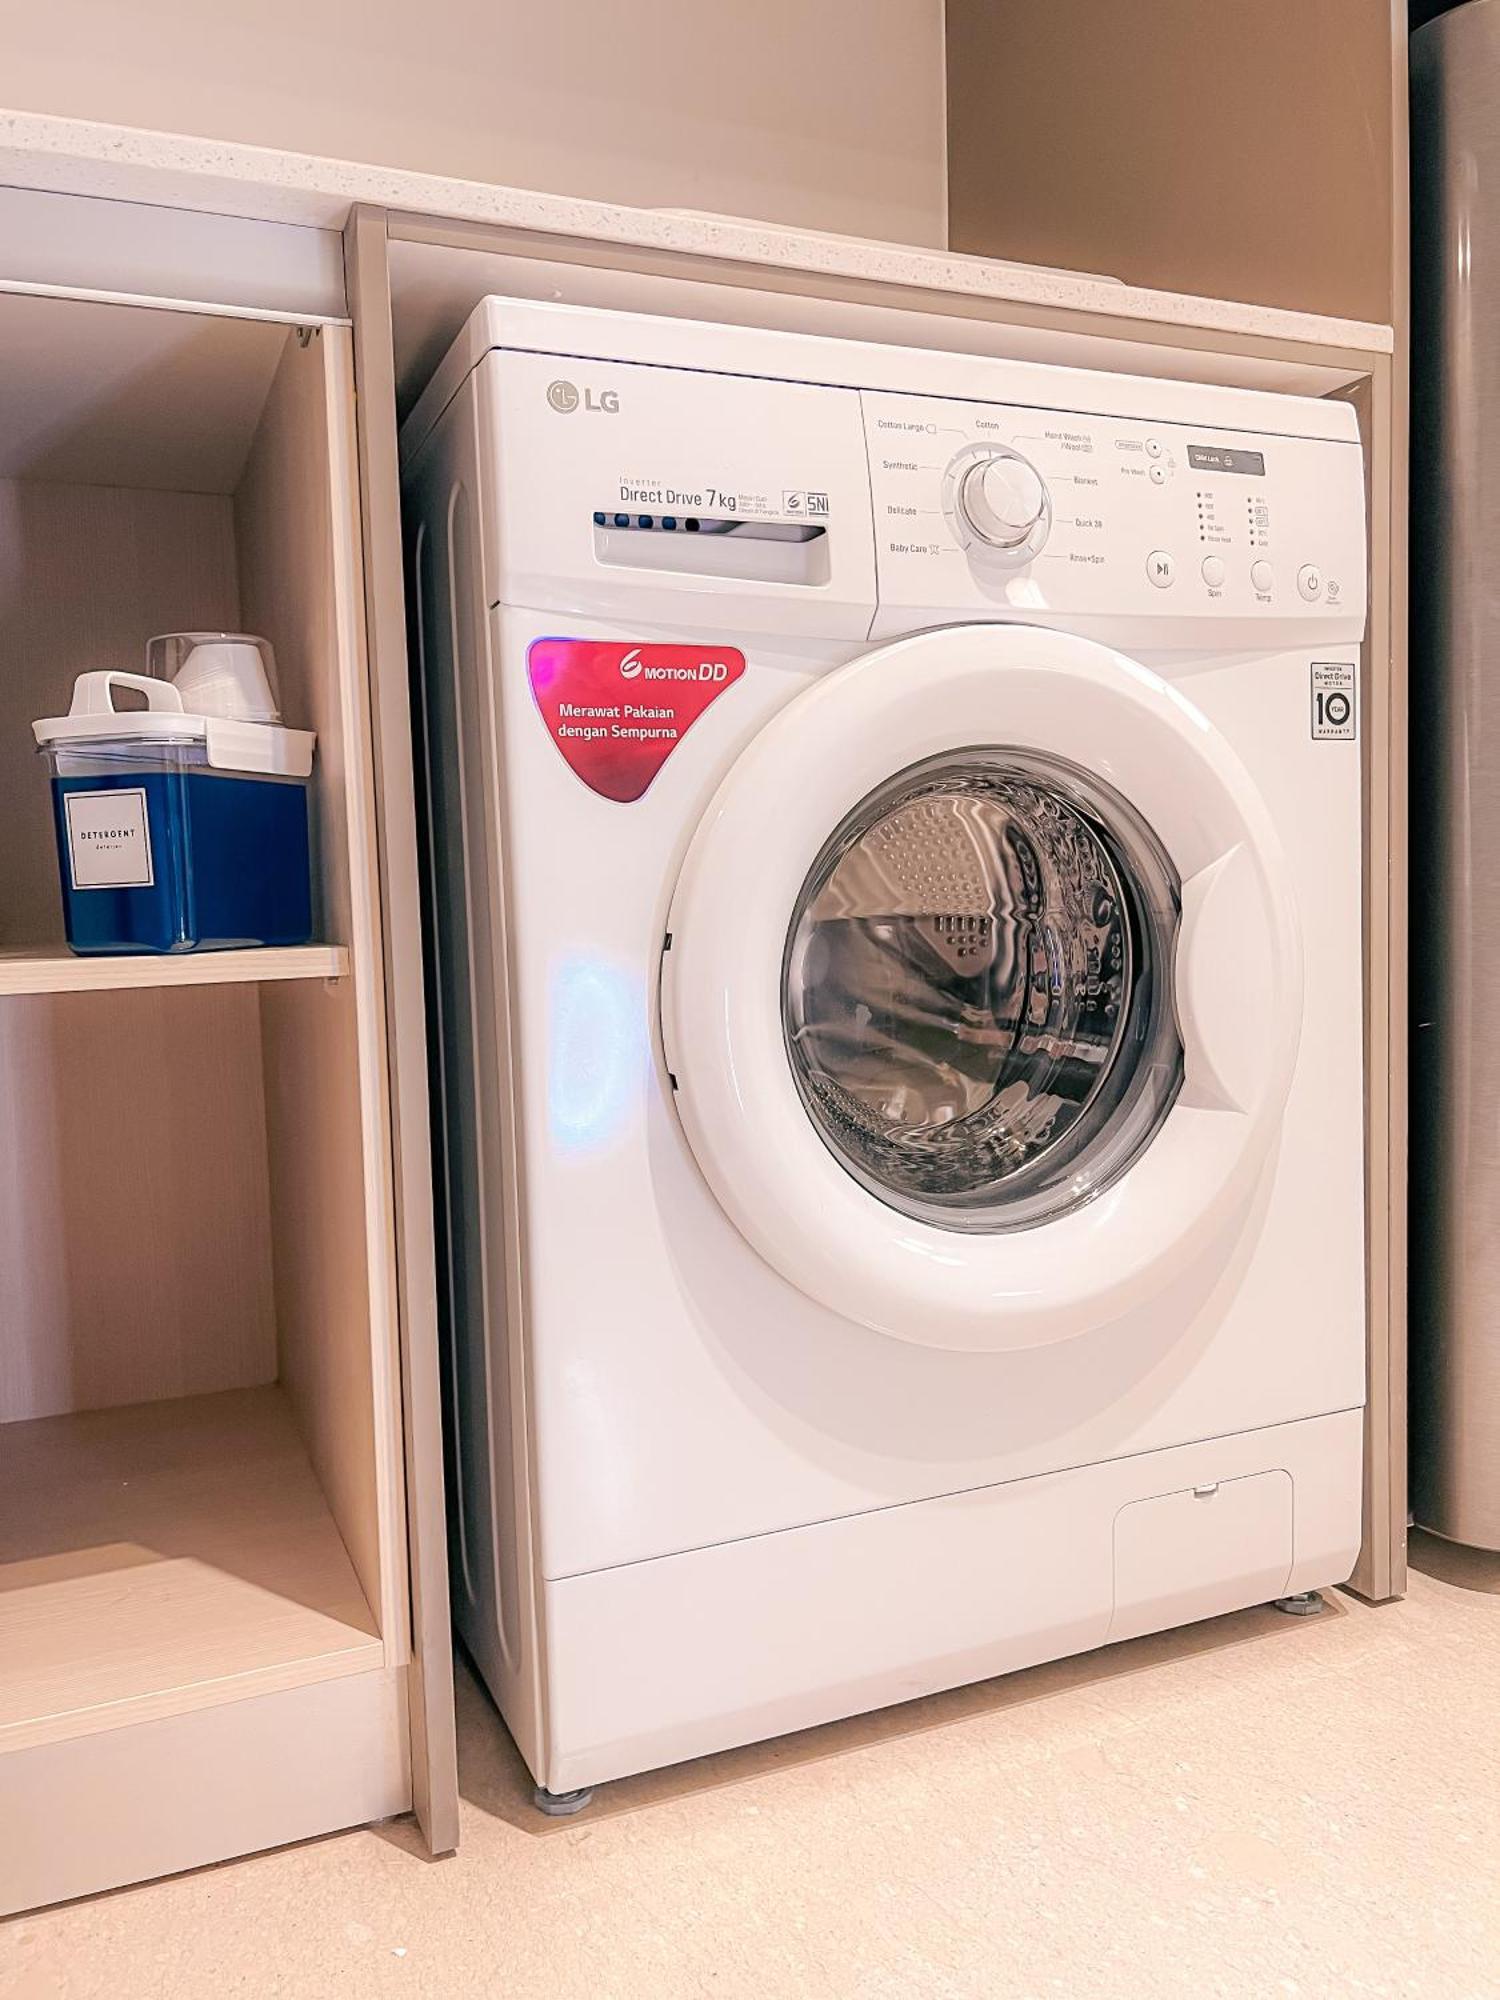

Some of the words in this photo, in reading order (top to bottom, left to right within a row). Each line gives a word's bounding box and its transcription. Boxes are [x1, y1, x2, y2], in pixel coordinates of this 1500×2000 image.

[585, 388, 619, 413] LG
[878, 418, 902, 429] Cotton
[975, 420, 1000, 430] Cotton
[882, 460, 918, 471] Synthetic
[619, 477, 662, 487] Inverter
[620, 486, 662, 503] Direct
[666, 490, 702, 506] Drive
[706, 489, 716, 507] 7
[719, 492, 736, 511] kg
[807, 496, 829, 512] SNI
[887, 506, 917, 516] Delicate
[1075, 518, 1092, 529] Quick
[890, 543, 909, 555] Baby
[910, 544, 927, 554] Care
[644, 666, 697, 681] MOTION
[1315, 672, 1334, 680] Direct
[559, 703, 620, 718] Merawat
[624, 704, 674, 719] Pakaian
[1316, 692, 1350, 725] 10
[558, 724, 608, 740] dengan
[611, 725, 678, 741] Sempurna
[81, 829, 135, 840] DETERGENT
